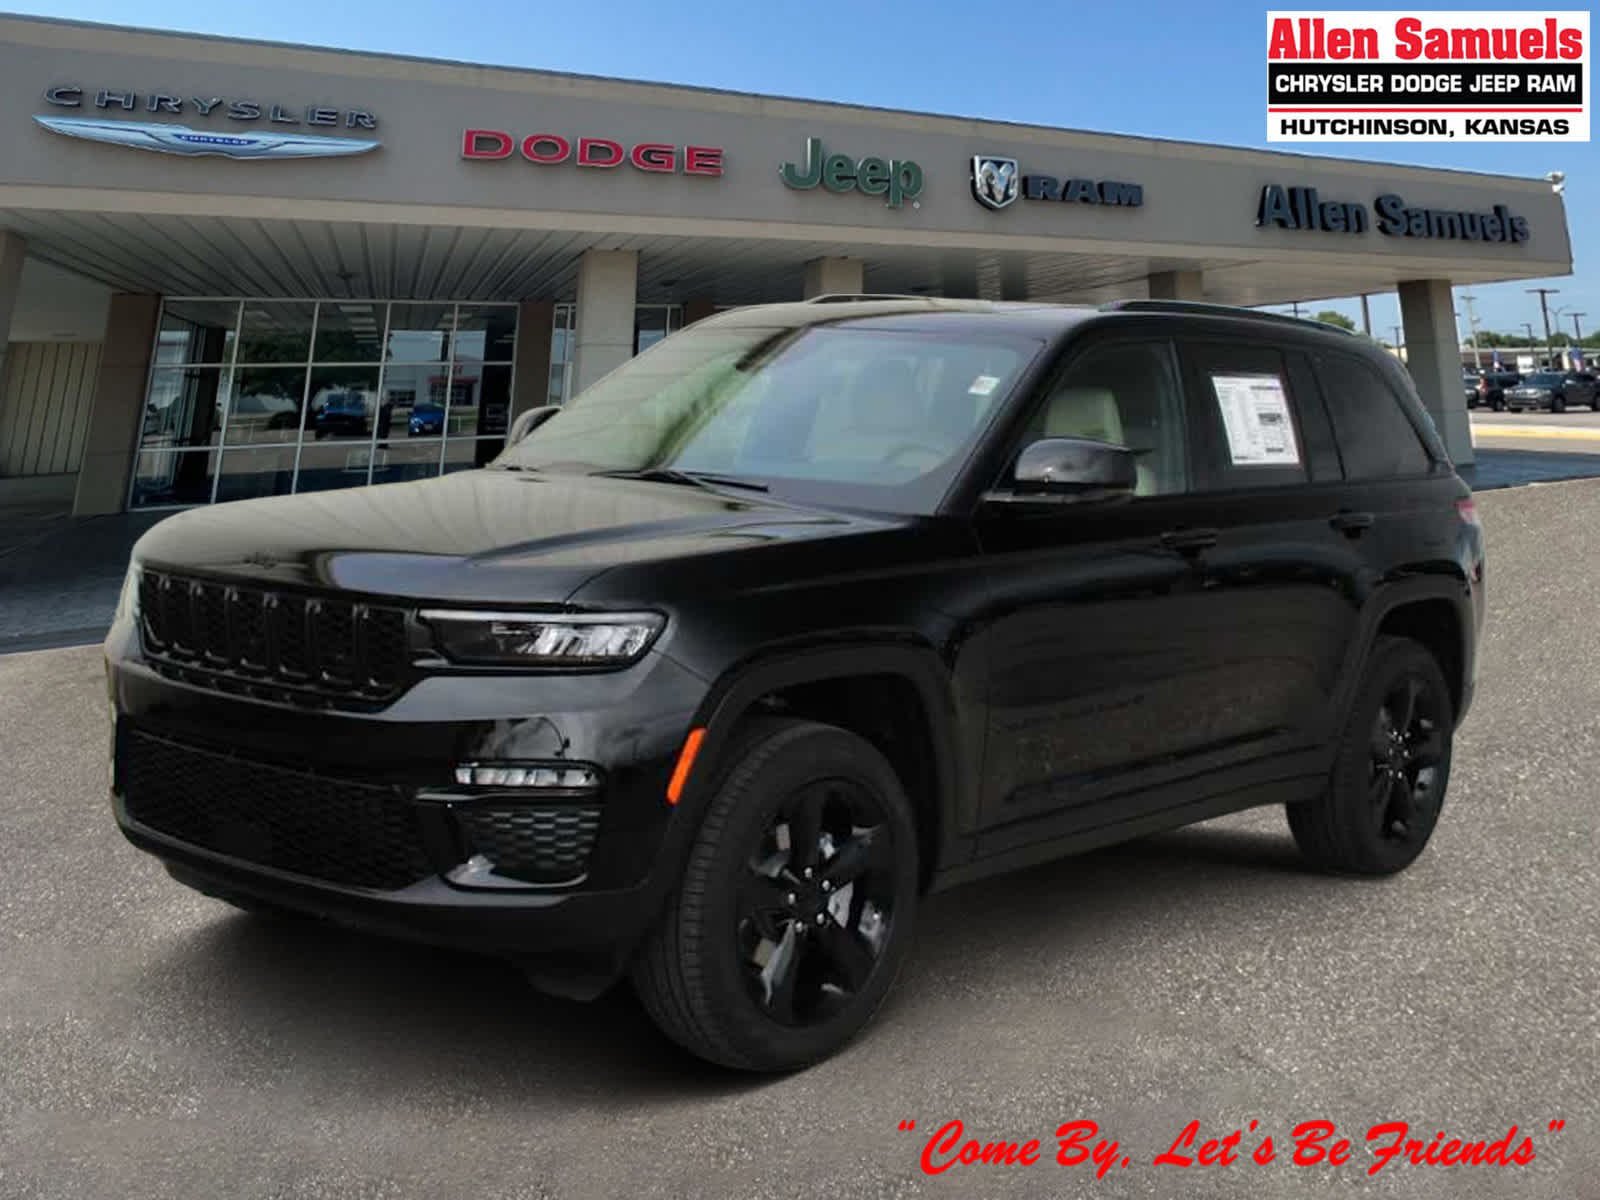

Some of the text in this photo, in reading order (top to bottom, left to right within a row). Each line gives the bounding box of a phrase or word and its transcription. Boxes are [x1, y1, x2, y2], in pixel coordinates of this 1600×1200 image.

[43, 85, 377, 129] CHRYSLER
[462, 128, 724, 176] DODGE
[779, 136, 924, 209] Jeep
[1024, 174, 1144, 208] RAM
[1255, 184, 1530, 244] Allen Samuels
